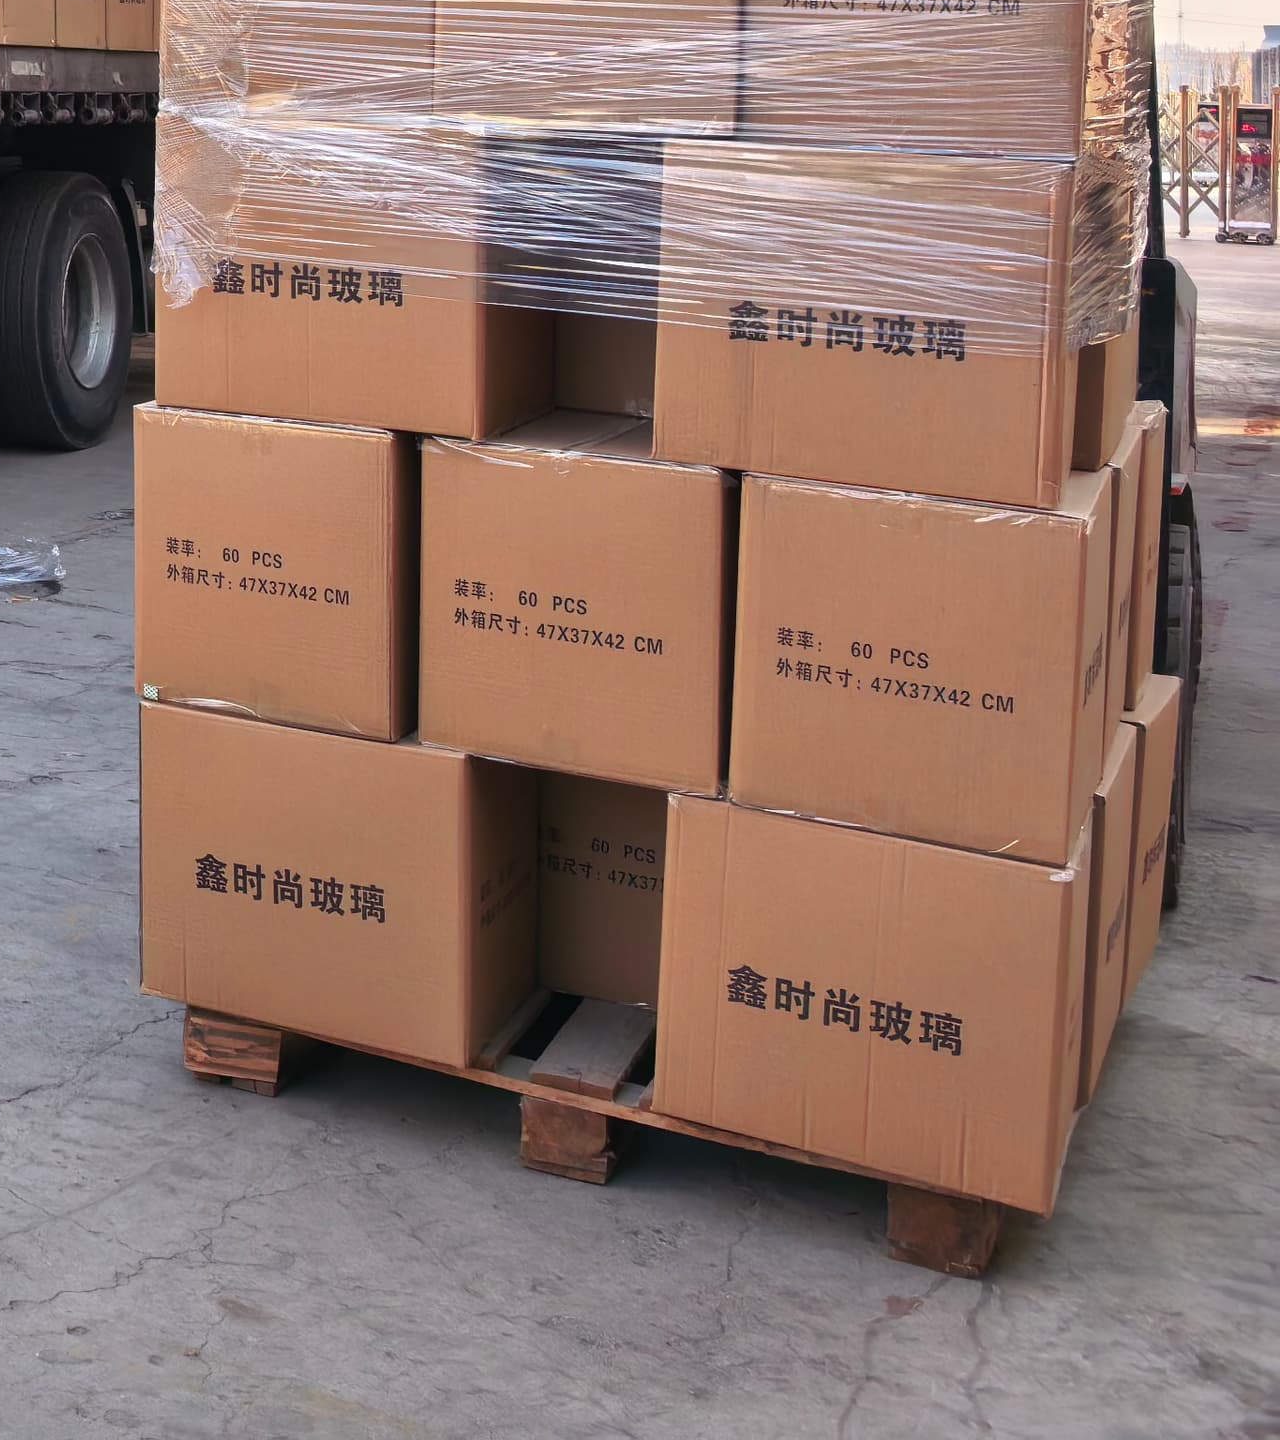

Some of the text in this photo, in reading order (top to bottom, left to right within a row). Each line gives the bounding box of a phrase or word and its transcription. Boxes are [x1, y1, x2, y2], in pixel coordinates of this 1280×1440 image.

[211, 258, 404, 307] 鑫时尚玻璃
[728, 299, 967, 363] 鑫时尚玻璃
[222, 547, 240, 564] 60
[251, 549, 283, 569] PCS
[239, 576, 318, 603] 47X37X42
[323, 587, 350, 606] CM
[518, 590, 538, 609] 60
[552, 595, 588, 616] PCS
[536, 623, 625, 651] 47X37X42
[634, 635, 664, 656] CM
[851, 641, 873, 660] 60
[890, 647, 930, 670] PCS
[870, 676, 971, 708] 47X37X42
[981, 693, 1015, 715] CM
[592, 837, 656, 864] 60 PCS
[194, 853, 387, 924] 鑫时尚玻璃
[608, 870, 664, 893] 47X37
[727, 964, 965, 1057] 鑫时尚玻璃
